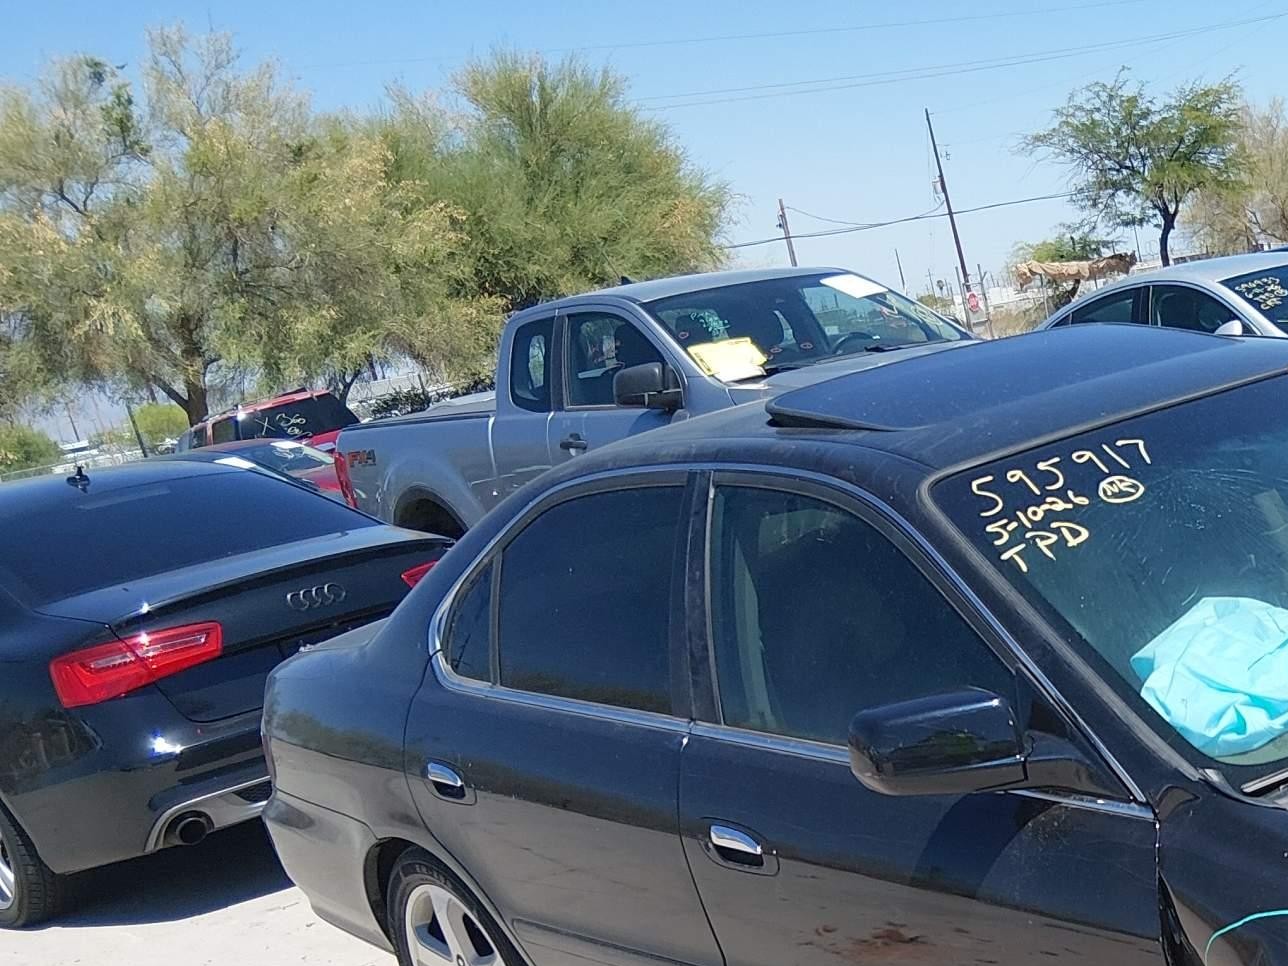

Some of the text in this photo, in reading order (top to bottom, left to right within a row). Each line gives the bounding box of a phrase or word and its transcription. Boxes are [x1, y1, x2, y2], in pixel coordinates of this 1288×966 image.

[971, 439, 1152, 517] 595917
[985, 490, 1090, 546] 5-10-26
[1000, 521, 1090, 573] TPD
